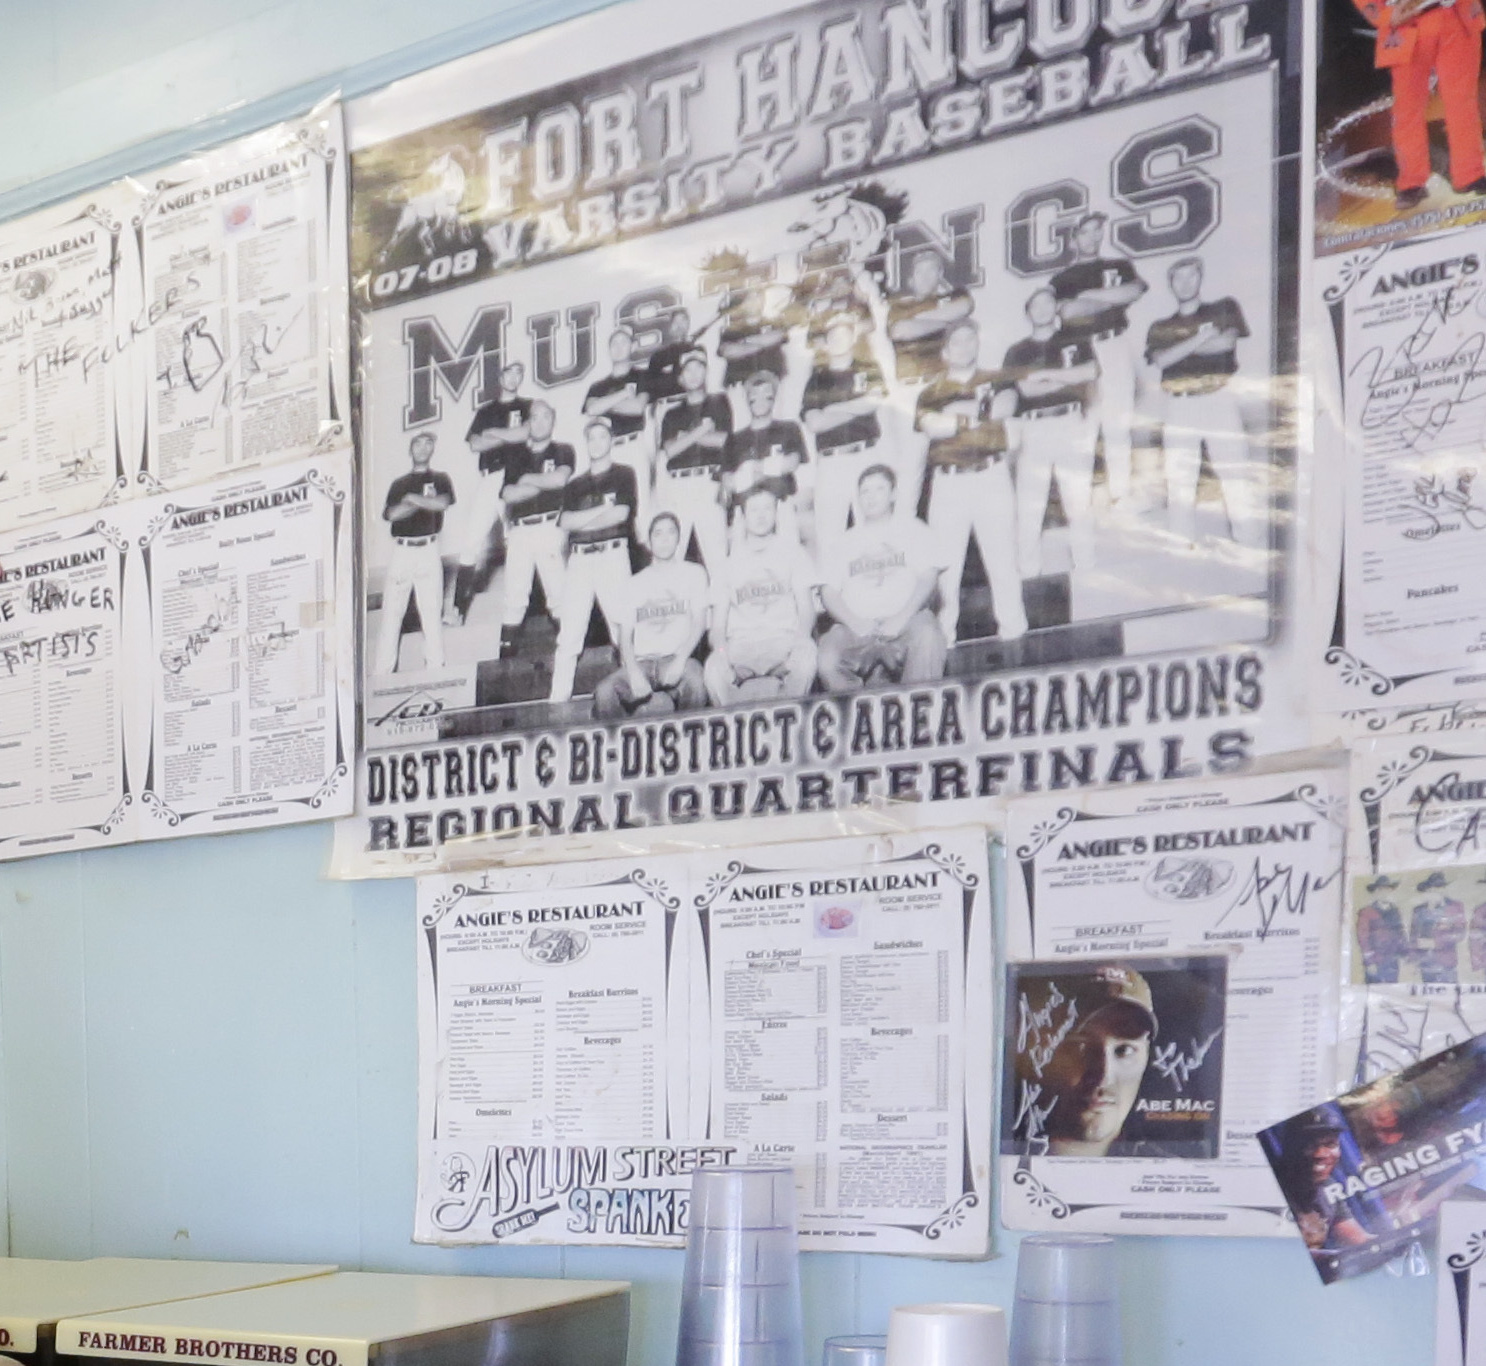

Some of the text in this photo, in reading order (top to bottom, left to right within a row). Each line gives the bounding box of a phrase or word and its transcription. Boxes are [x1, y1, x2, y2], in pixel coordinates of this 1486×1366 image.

[483, 0, 1225, 215] FORT HANCO
[483, 5, 1271, 268] VARSITY BASEBALL
[157, 153, 308, 215] ANGIE'S RESTAURANT
[13, 231, 96, 269] RESTAURANT
[374, 249, 477, 296] 07-08
[1371, 253, 1479, 297] ANGIE'S
[1394, 352, 1481, 379] BREAKFAST
[171, 487, 309, 530] ANGIE'S RESTAURANT
[26, 547, 108, 578] RESTAURANT
[1407, 584, 1459, 600] Pancakes
[3, 631, 98, 675] ARTISTS
[367, 739, 523, 805] DISTRICT
[569, 706, 797, 785] BI-DISTRICT
[850, 689, 965, 755] AREA
[980, 652, 1264, 741] CHAMPIONS
[367, 729, 1254, 851] REGIONAL QUARTERFINALS
[1058, 822, 1315, 861] ANGIE'S RESTAURANT
[728, 870, 942, 903] ANGIE'S RESTAURANT
[453, 901, 646, 929] ANGIE'S RESTAURANT
[1076, 924, 1144, 938] BREAKFAST
[772, 947, 802, 961] Special
[468, 983, 523, 994] BREAKFAST
[514, 995, 543, 1006] Special
[568, 988, 605, 999] Breakfast
[583, 1036, 622, 1046] Beverages
[1136, 1098, 1216, 1112] ABE MAC
[430, 1145, 737, 1232] ASYLUM STREET
[1131, 1185, 1156, 1193] CASH
[1158, 1185, 1183, 1193] ONLY
[1323, 1142, 1441, 1204] RAGING
[567, 1187, 691, 1236] SPANKE
[77, 1331, 166, 1355] FARMER
[174, 1337, 297, 1365] BROTHERS
